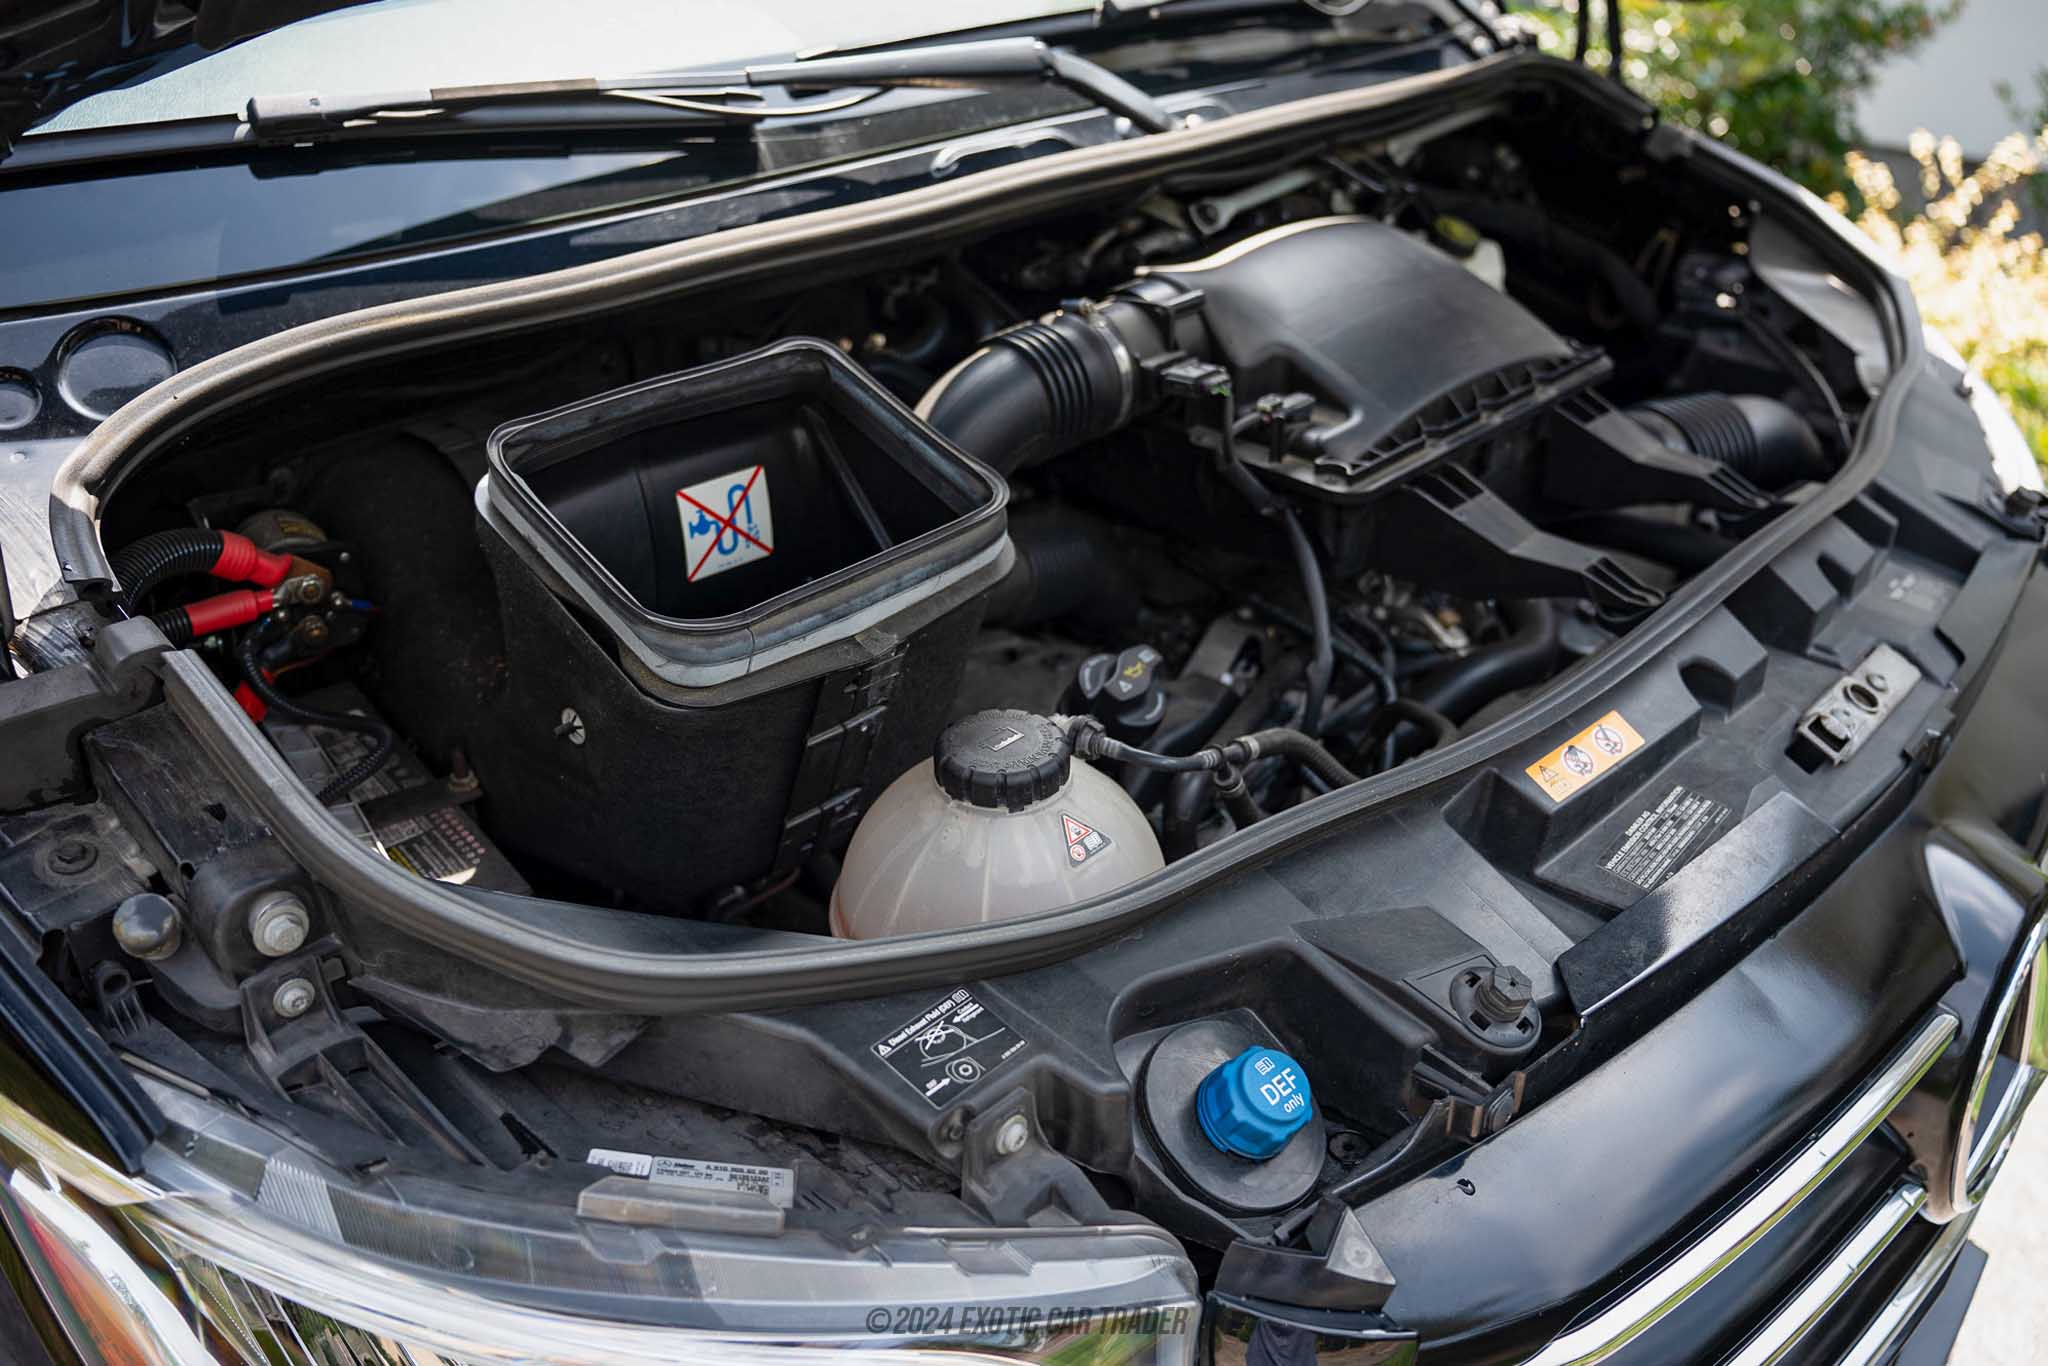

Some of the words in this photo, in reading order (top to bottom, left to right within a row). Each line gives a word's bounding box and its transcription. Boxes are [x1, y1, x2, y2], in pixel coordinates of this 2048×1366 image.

[1605, 850, 1625, 869] VEHICLE
[1638, 812, 1660, 833] CONTROL
[1260, 1067, 1296, 1106] DEF
[1283, 1093, 1305, 1113] only
